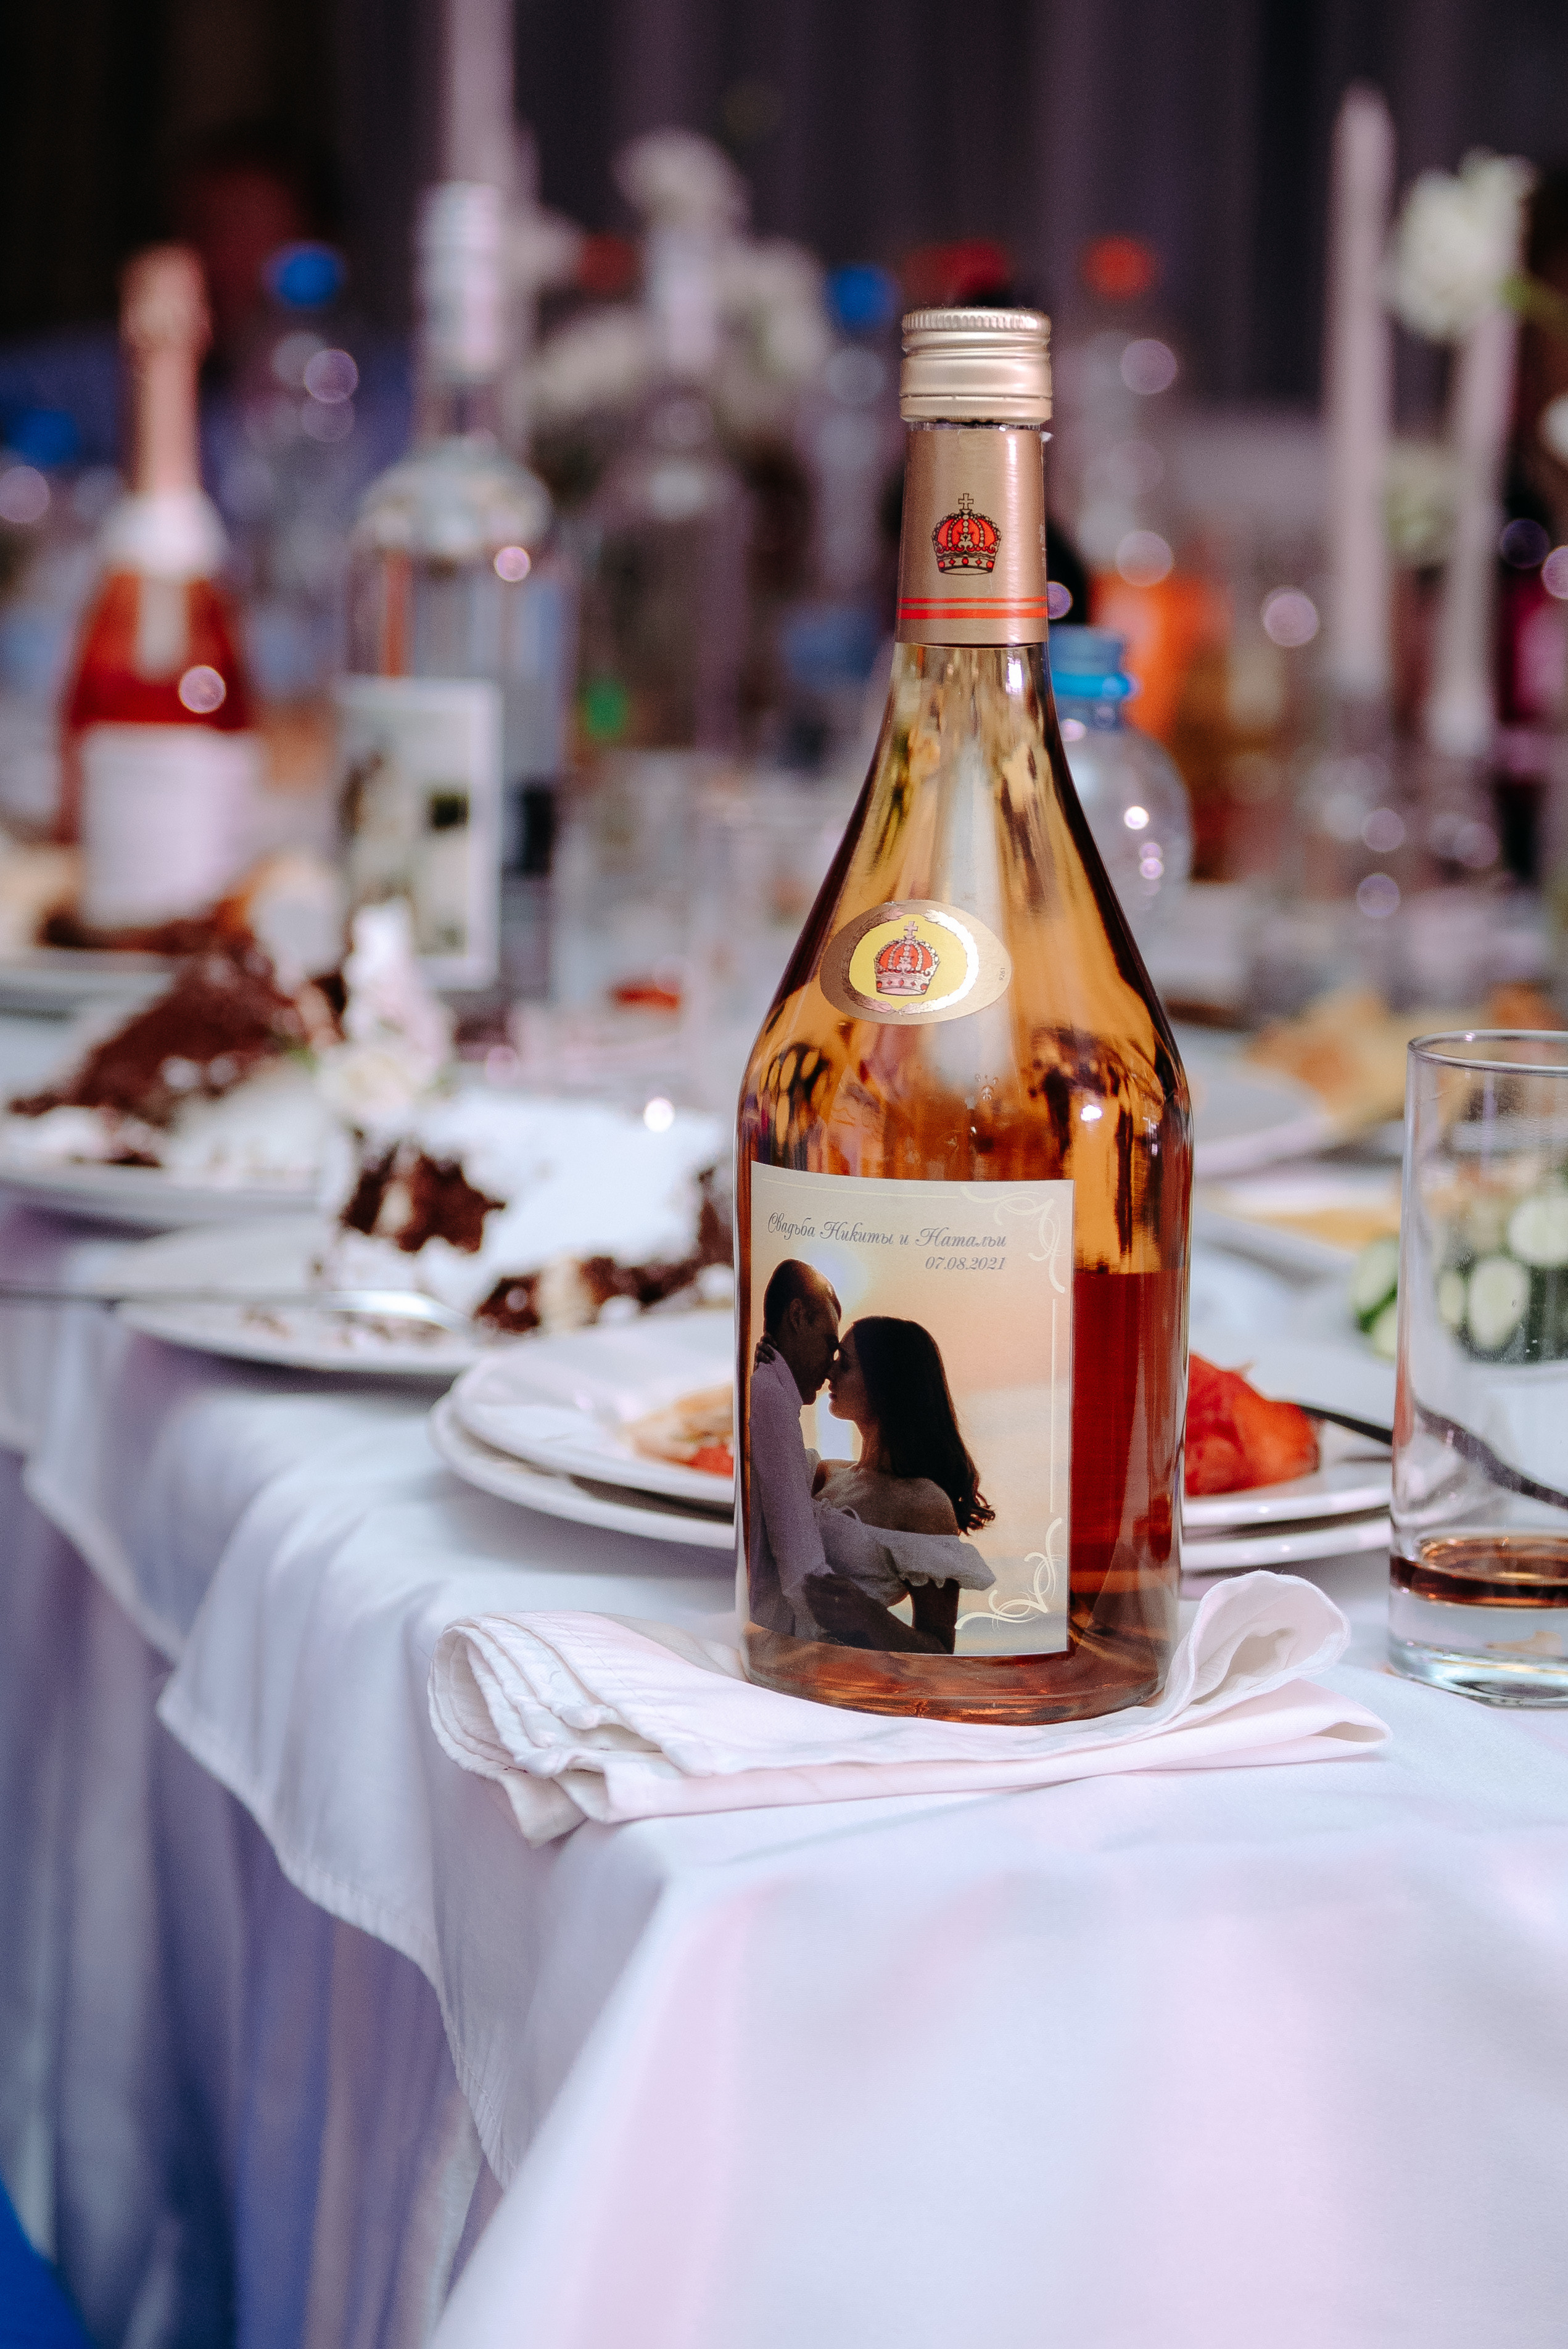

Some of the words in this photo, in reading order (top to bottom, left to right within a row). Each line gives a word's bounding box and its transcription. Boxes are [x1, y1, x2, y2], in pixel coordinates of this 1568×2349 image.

[768, 1212, 815, 1241] Свадьба
[819, 1221, 894, 1245] Никиты
[899, 1234, 909, 1245] и
[915, 1227, 1007, 1247] Натальи
[925, 1256, 1006, 1270] 07.08.2021
